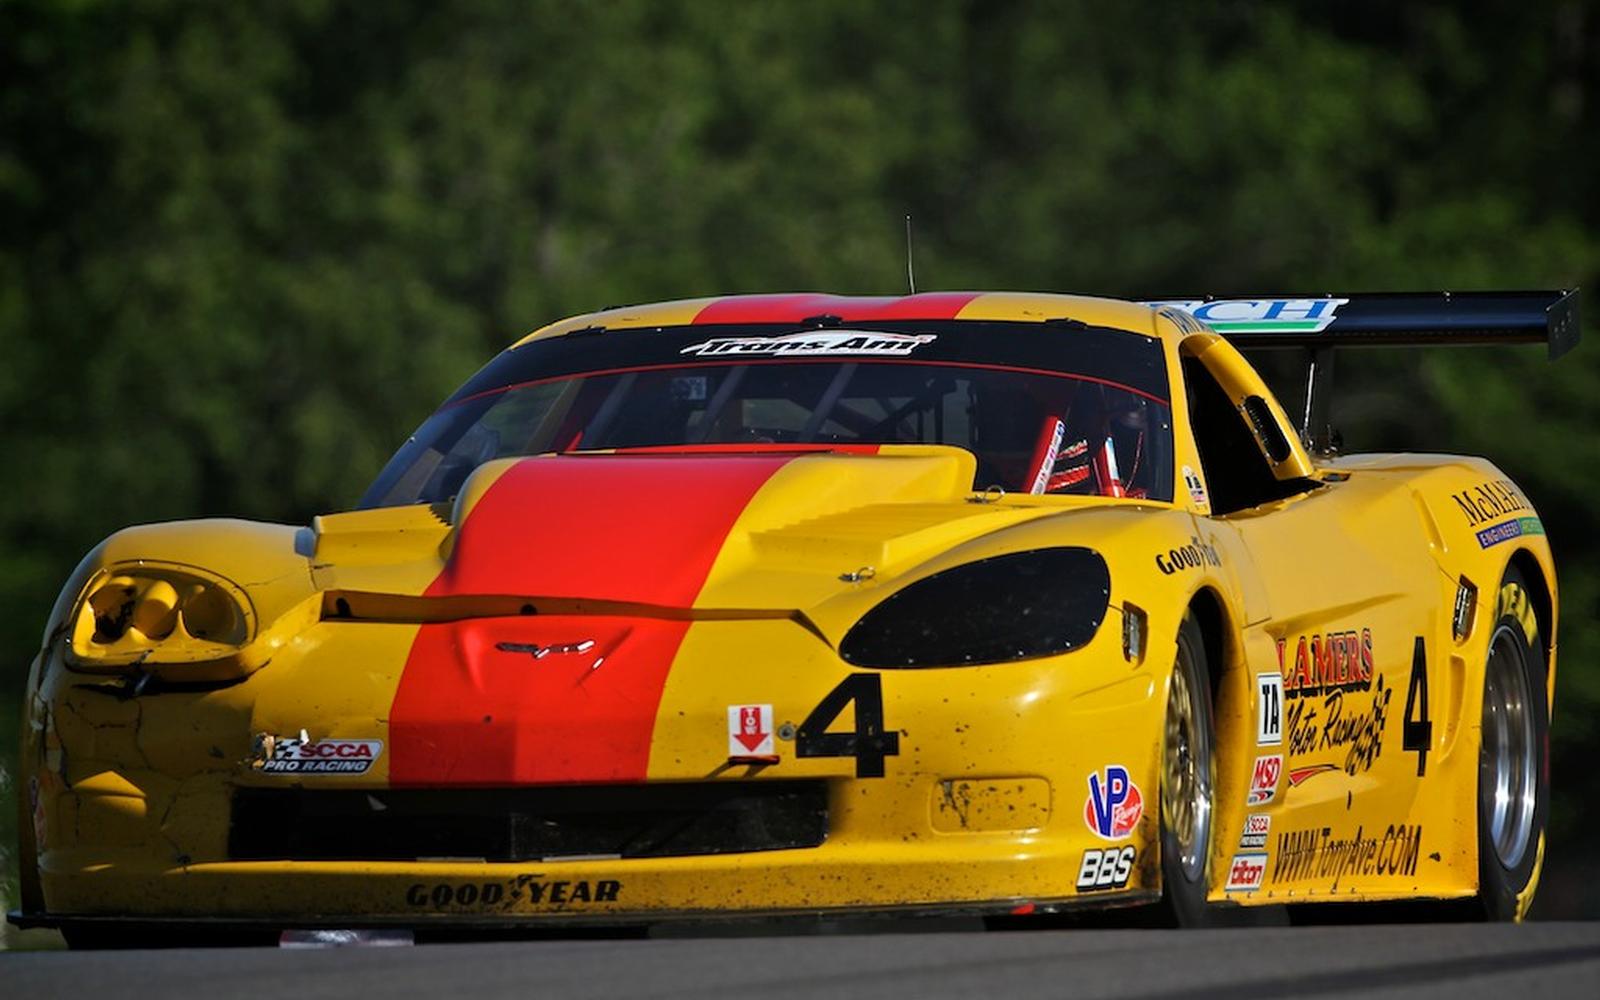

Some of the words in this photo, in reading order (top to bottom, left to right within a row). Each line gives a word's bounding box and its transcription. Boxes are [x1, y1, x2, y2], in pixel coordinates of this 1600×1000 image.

[1276, 628, 1374, 697] LAMERS
[745, 708, 757, 736] TOW
[796, 673, 899, 778] 4
[1262, 684, 1280, 735] TA
[1403, 637, 1432, 777] 4
[264, 760, 300, 771] PRO
[302, 760, 369, 771] RACING
[299, 743, 373, 757] SCCA
[1252, 757, 1281, 790] MSD
[1089, 766, 1129, 837] VP
[1077, 846, 1136, 891] BBS
